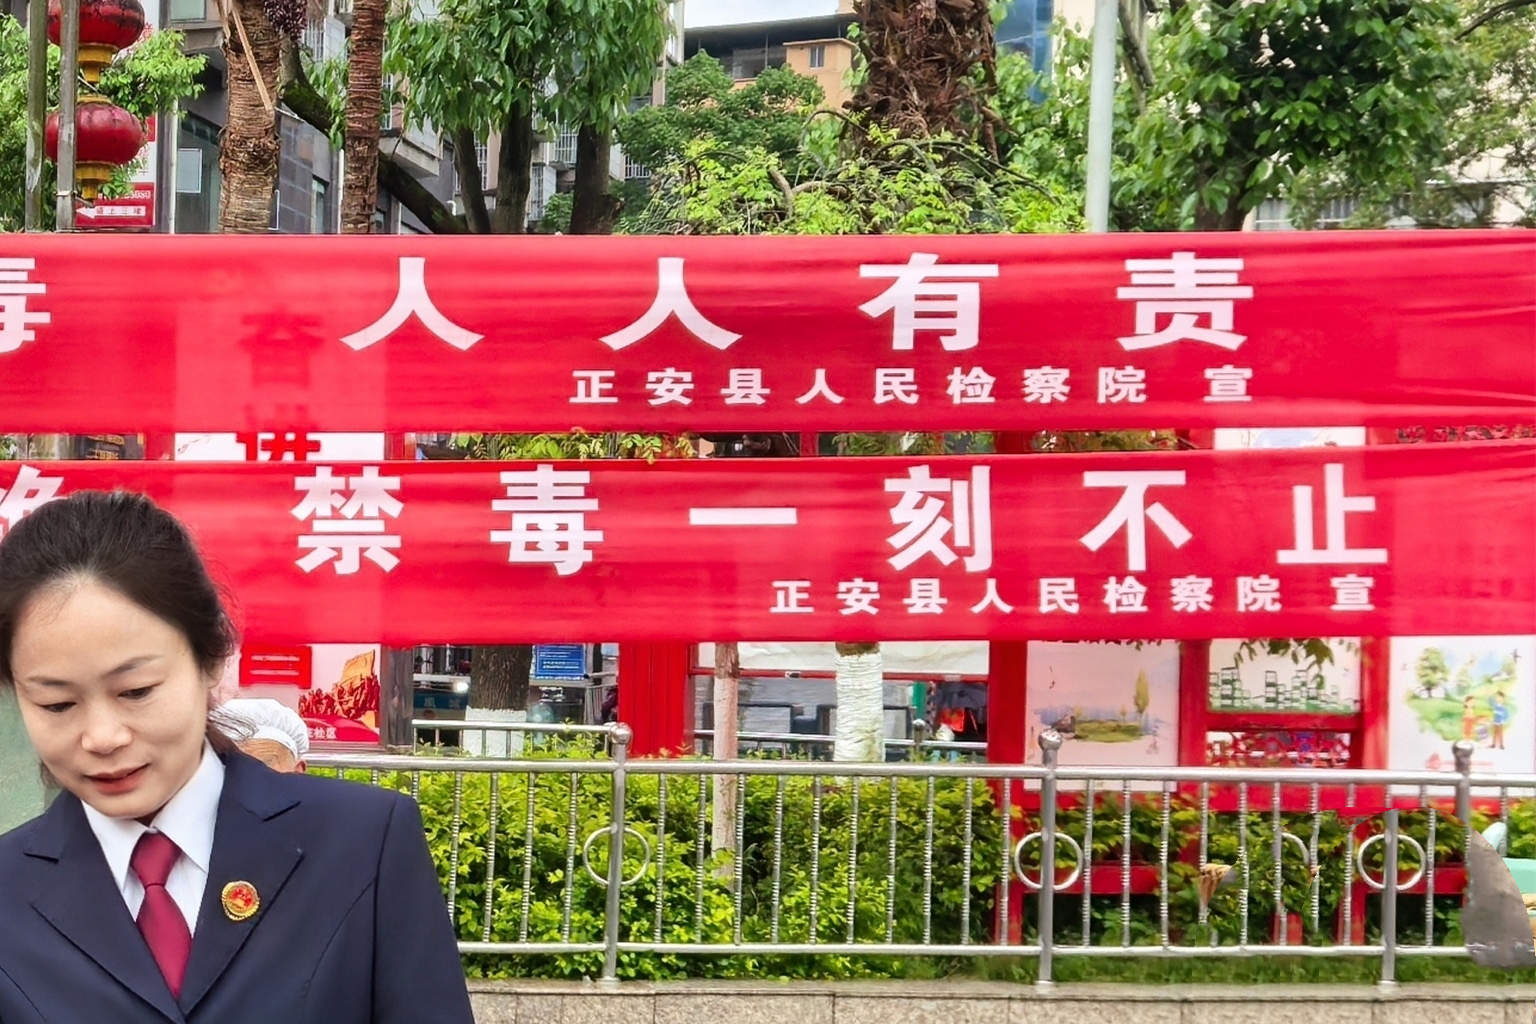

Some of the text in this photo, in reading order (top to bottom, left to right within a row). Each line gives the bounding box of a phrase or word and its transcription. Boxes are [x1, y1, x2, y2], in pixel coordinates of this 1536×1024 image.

[341, 252, 1252, 350] 人人有责
[570, 365, 1254, 405] 正安县人民检察院 宣
[290, 464, 1388, 576] 禁毒一刻不止
[771, 574, 1375, 614] 正安县人民检察院 宣
